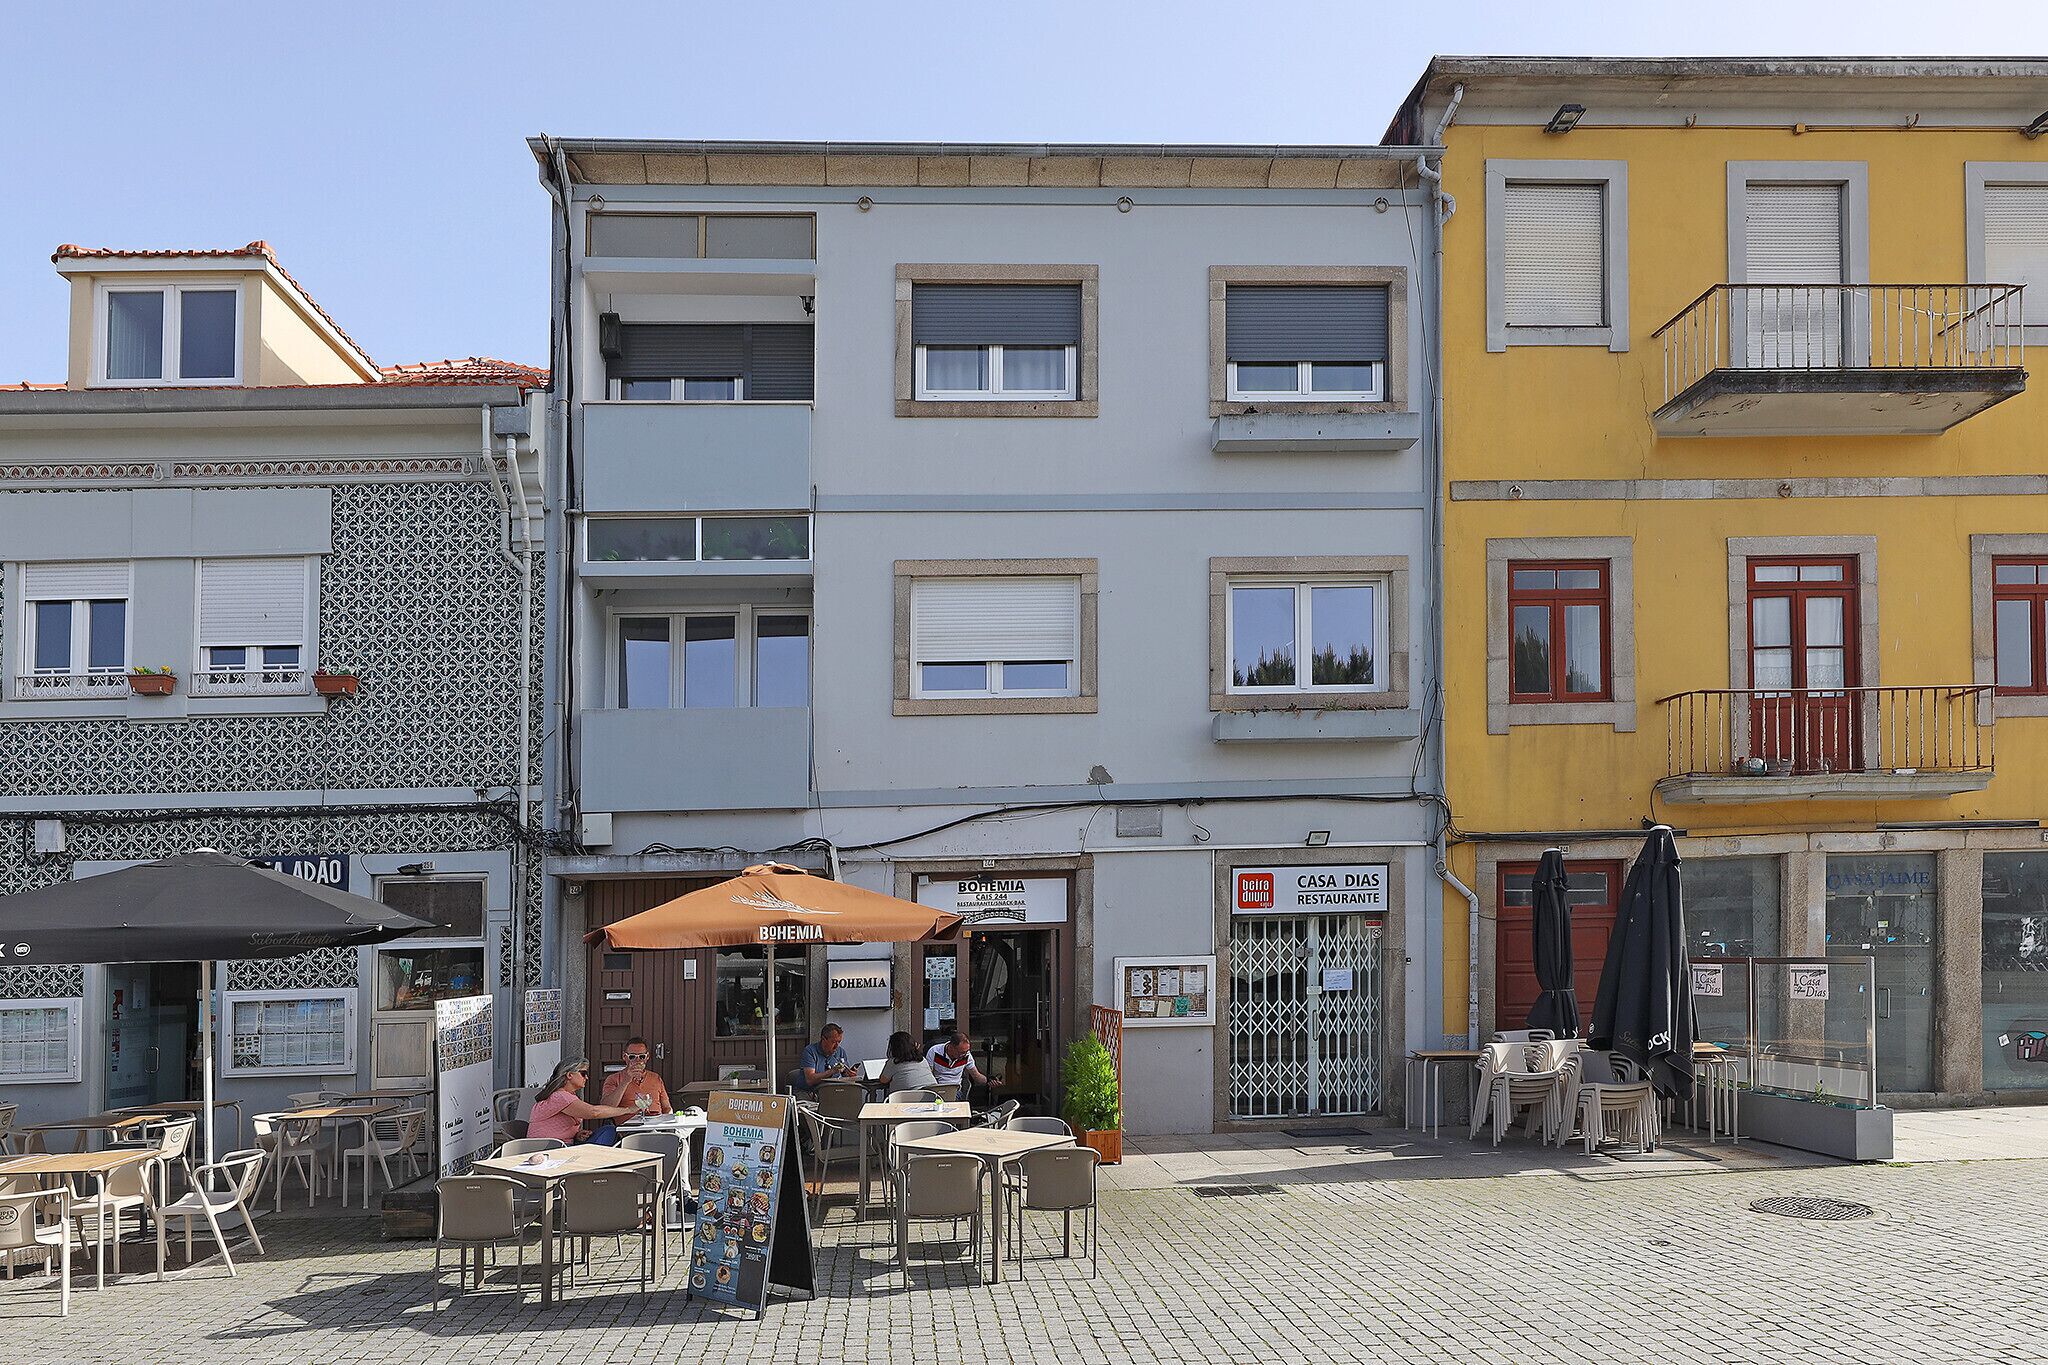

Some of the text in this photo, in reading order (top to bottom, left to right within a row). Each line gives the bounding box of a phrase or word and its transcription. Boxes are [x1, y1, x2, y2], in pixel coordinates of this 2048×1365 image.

[293, 857, 342, 883] ADÃO
[958, 880, 1025, 892] BOHEMIA
[1242, 879, 1269, 891] beira
[1298, 873, 1380, 888] CASA DIAS
[1826, 872, 1930, 890] CASA JAIME
[1298, 893, 1380, 905] RESTAURANTE
[760, 925, 823, 940] BOHEMIA
[831, 977, 887, 989] BOHEMIA
[1800, 975, 1820, 986] Casa
[1705, 983, 1721, 994] Dias
[1806, 986, 1827, 997] Dias
[1648, 1030, 1671, 1050] OCK
[728, 1098, 763, 1112] BOHEMIA
[723, 1126, 763, 1139] BOHEMIA
